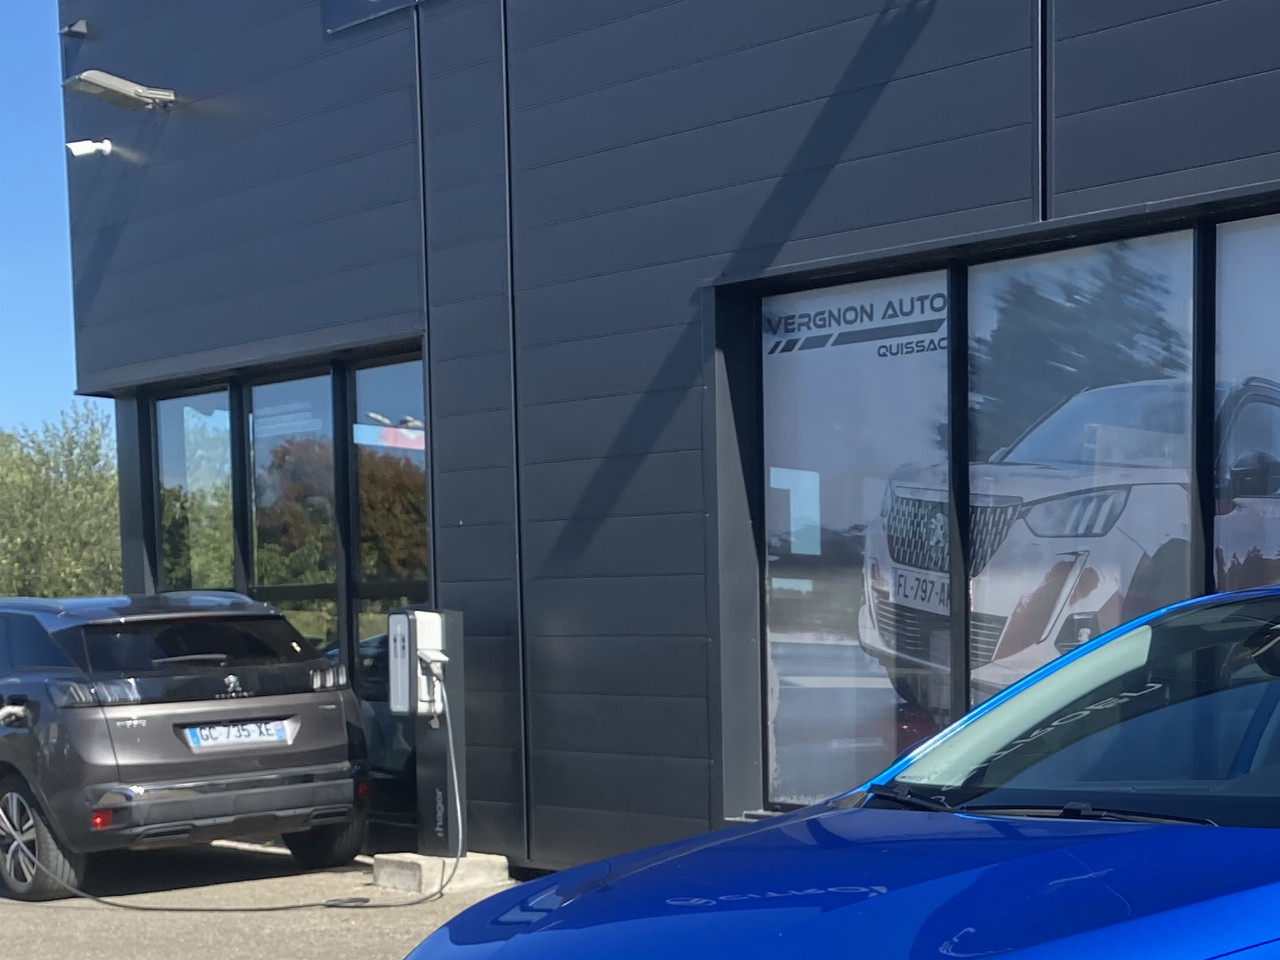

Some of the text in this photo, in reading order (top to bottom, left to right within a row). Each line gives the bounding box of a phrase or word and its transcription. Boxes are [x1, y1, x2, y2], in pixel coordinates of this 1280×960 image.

[766, 292, 948, 335] VERGNON AUTO
[877, 337, 948, 357] QUISSAC
